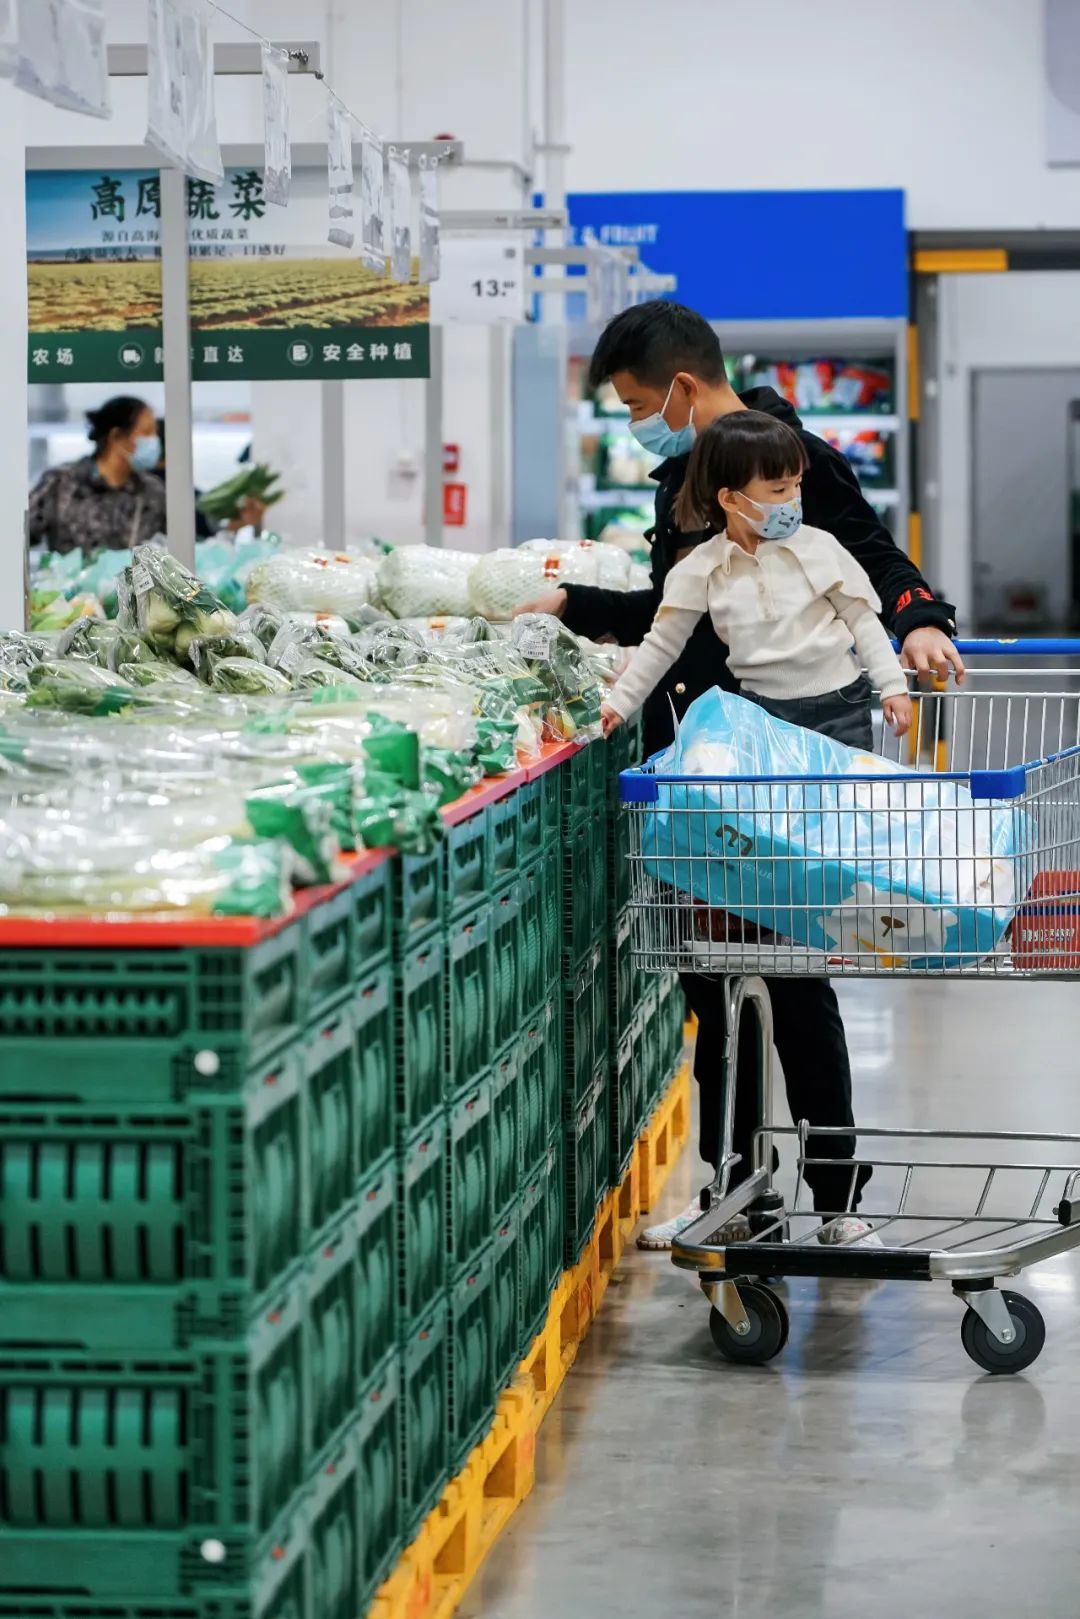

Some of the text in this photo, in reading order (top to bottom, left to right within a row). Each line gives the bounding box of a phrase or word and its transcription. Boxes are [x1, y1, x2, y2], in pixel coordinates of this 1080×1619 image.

[32, 347, 74, 366] 农场
[322, 342, 413, 361] 安全种植
